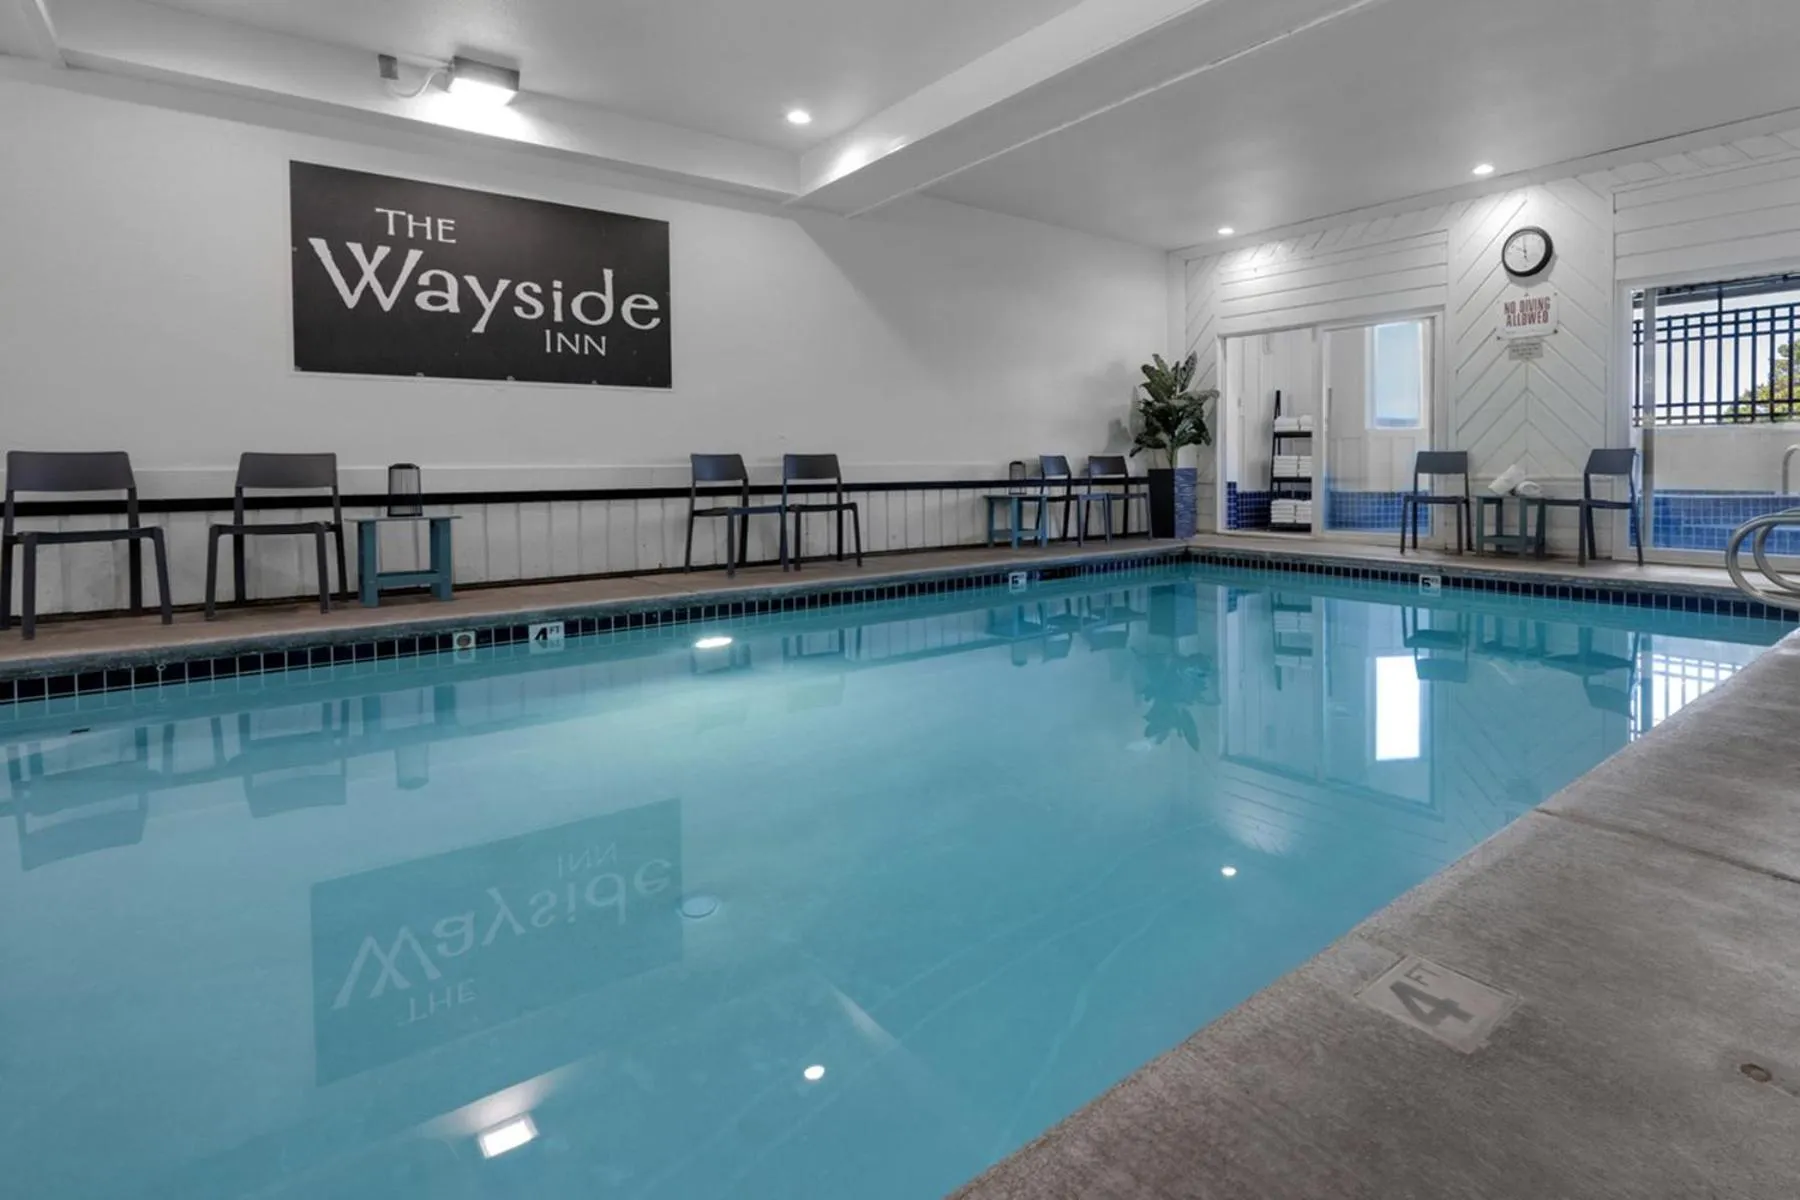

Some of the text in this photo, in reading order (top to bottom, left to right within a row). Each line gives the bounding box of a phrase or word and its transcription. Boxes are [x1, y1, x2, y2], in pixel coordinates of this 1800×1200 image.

[375, 207, 457, 243] THE
[308, 236, 661, 334] Wayside
[1504, 297, 1551, 315] NO DIVING
[1505, 310, 1549, 327] ALLOWED
[544, 329, 607, 356] INN
[549, 625, 561, 634] FT
[1389, 979, 1476, 1027] 4
